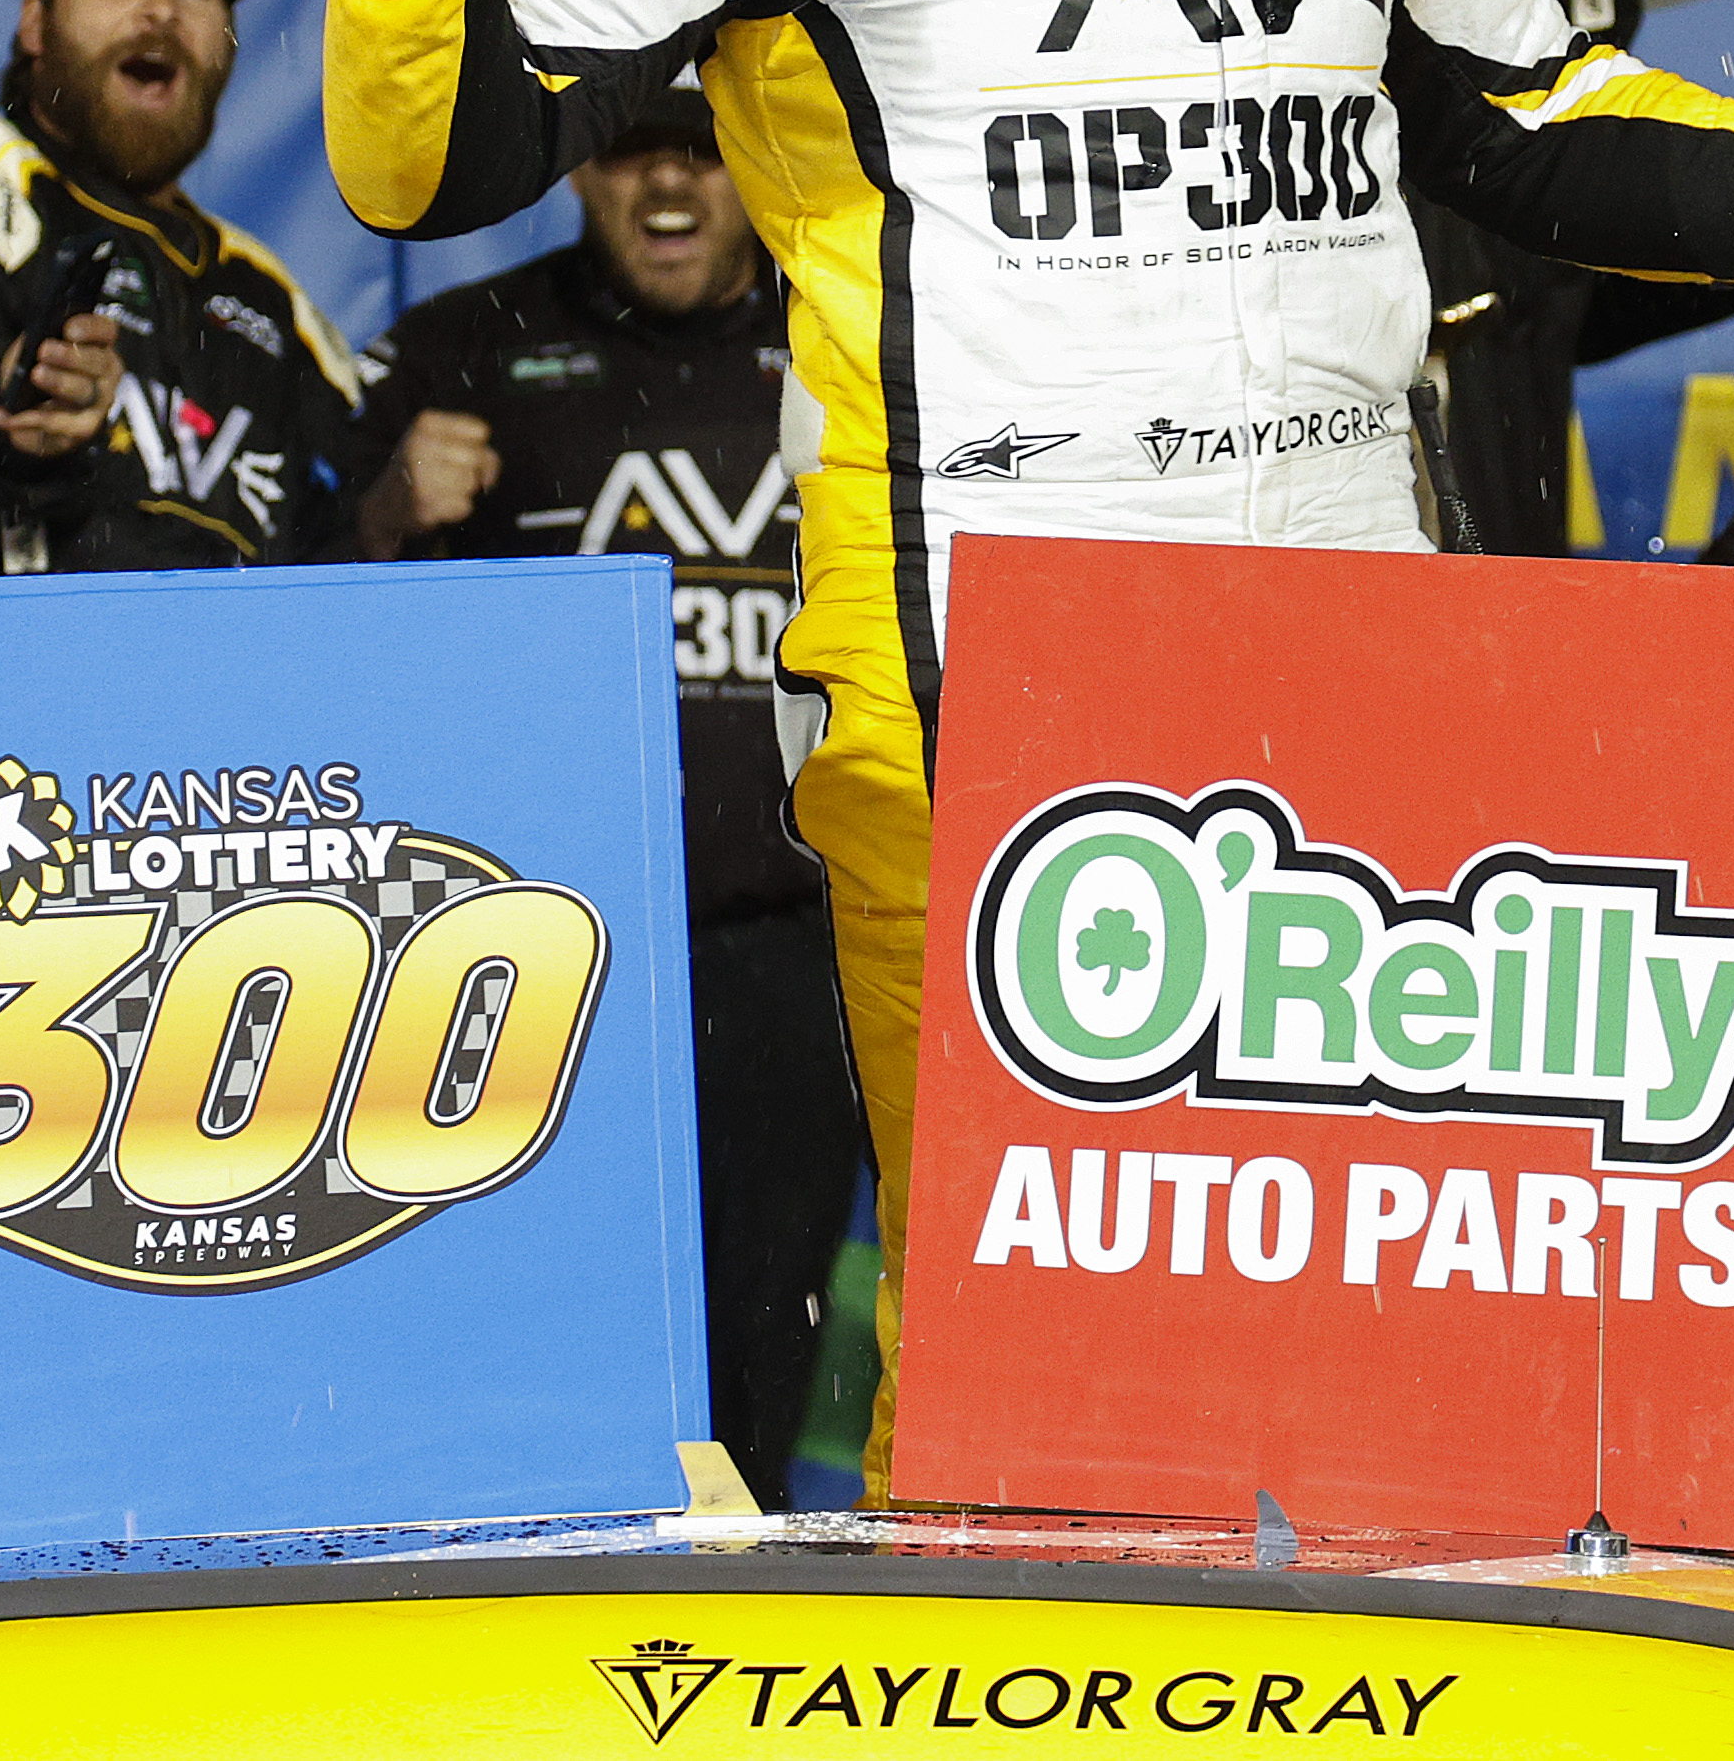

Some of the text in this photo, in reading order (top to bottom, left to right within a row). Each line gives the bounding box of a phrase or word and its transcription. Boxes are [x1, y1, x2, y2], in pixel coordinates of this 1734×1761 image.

[984, 95, 1380, 240] OP300
[996, 254, 1022, 271] IN
[1036, 253, 1130, 271] HONOR
[1142, 251, 1173, 268] OF
[92, 766, 360, 829] KANSAS
[92, 826, 400, 893] LOTTERY
[135, 1214, 297, 1249] KANSAS
[973, 1144, 1315, 1285] AUTO
[134, 1243, 293, 1265] SPEEDWAY
